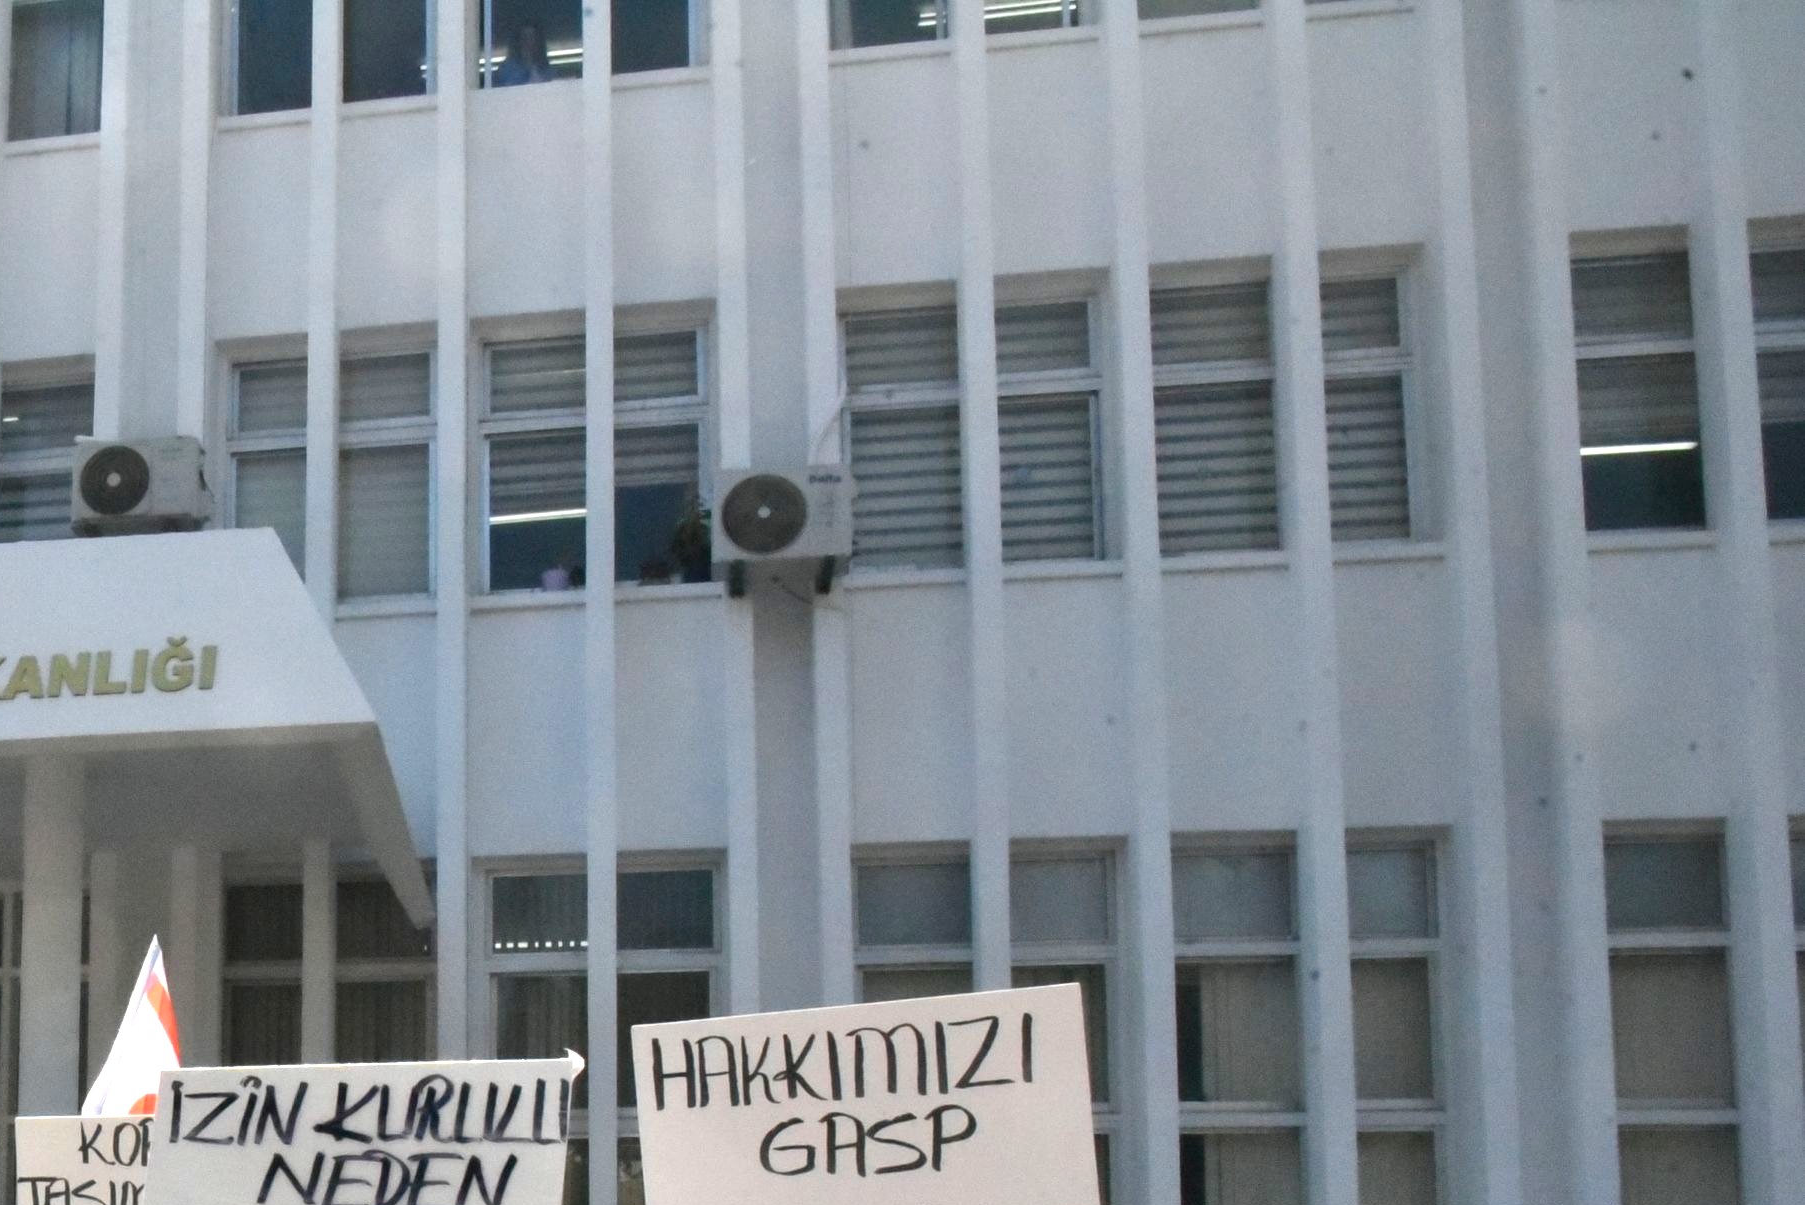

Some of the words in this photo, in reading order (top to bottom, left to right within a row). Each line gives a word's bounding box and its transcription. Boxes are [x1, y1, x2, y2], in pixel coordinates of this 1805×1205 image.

[651, 1012, 1033, 1112] HAKKIMIZI
[168, 1074, 309, 1146] İZİN
[758, 1103, 978, 1178] GASP
